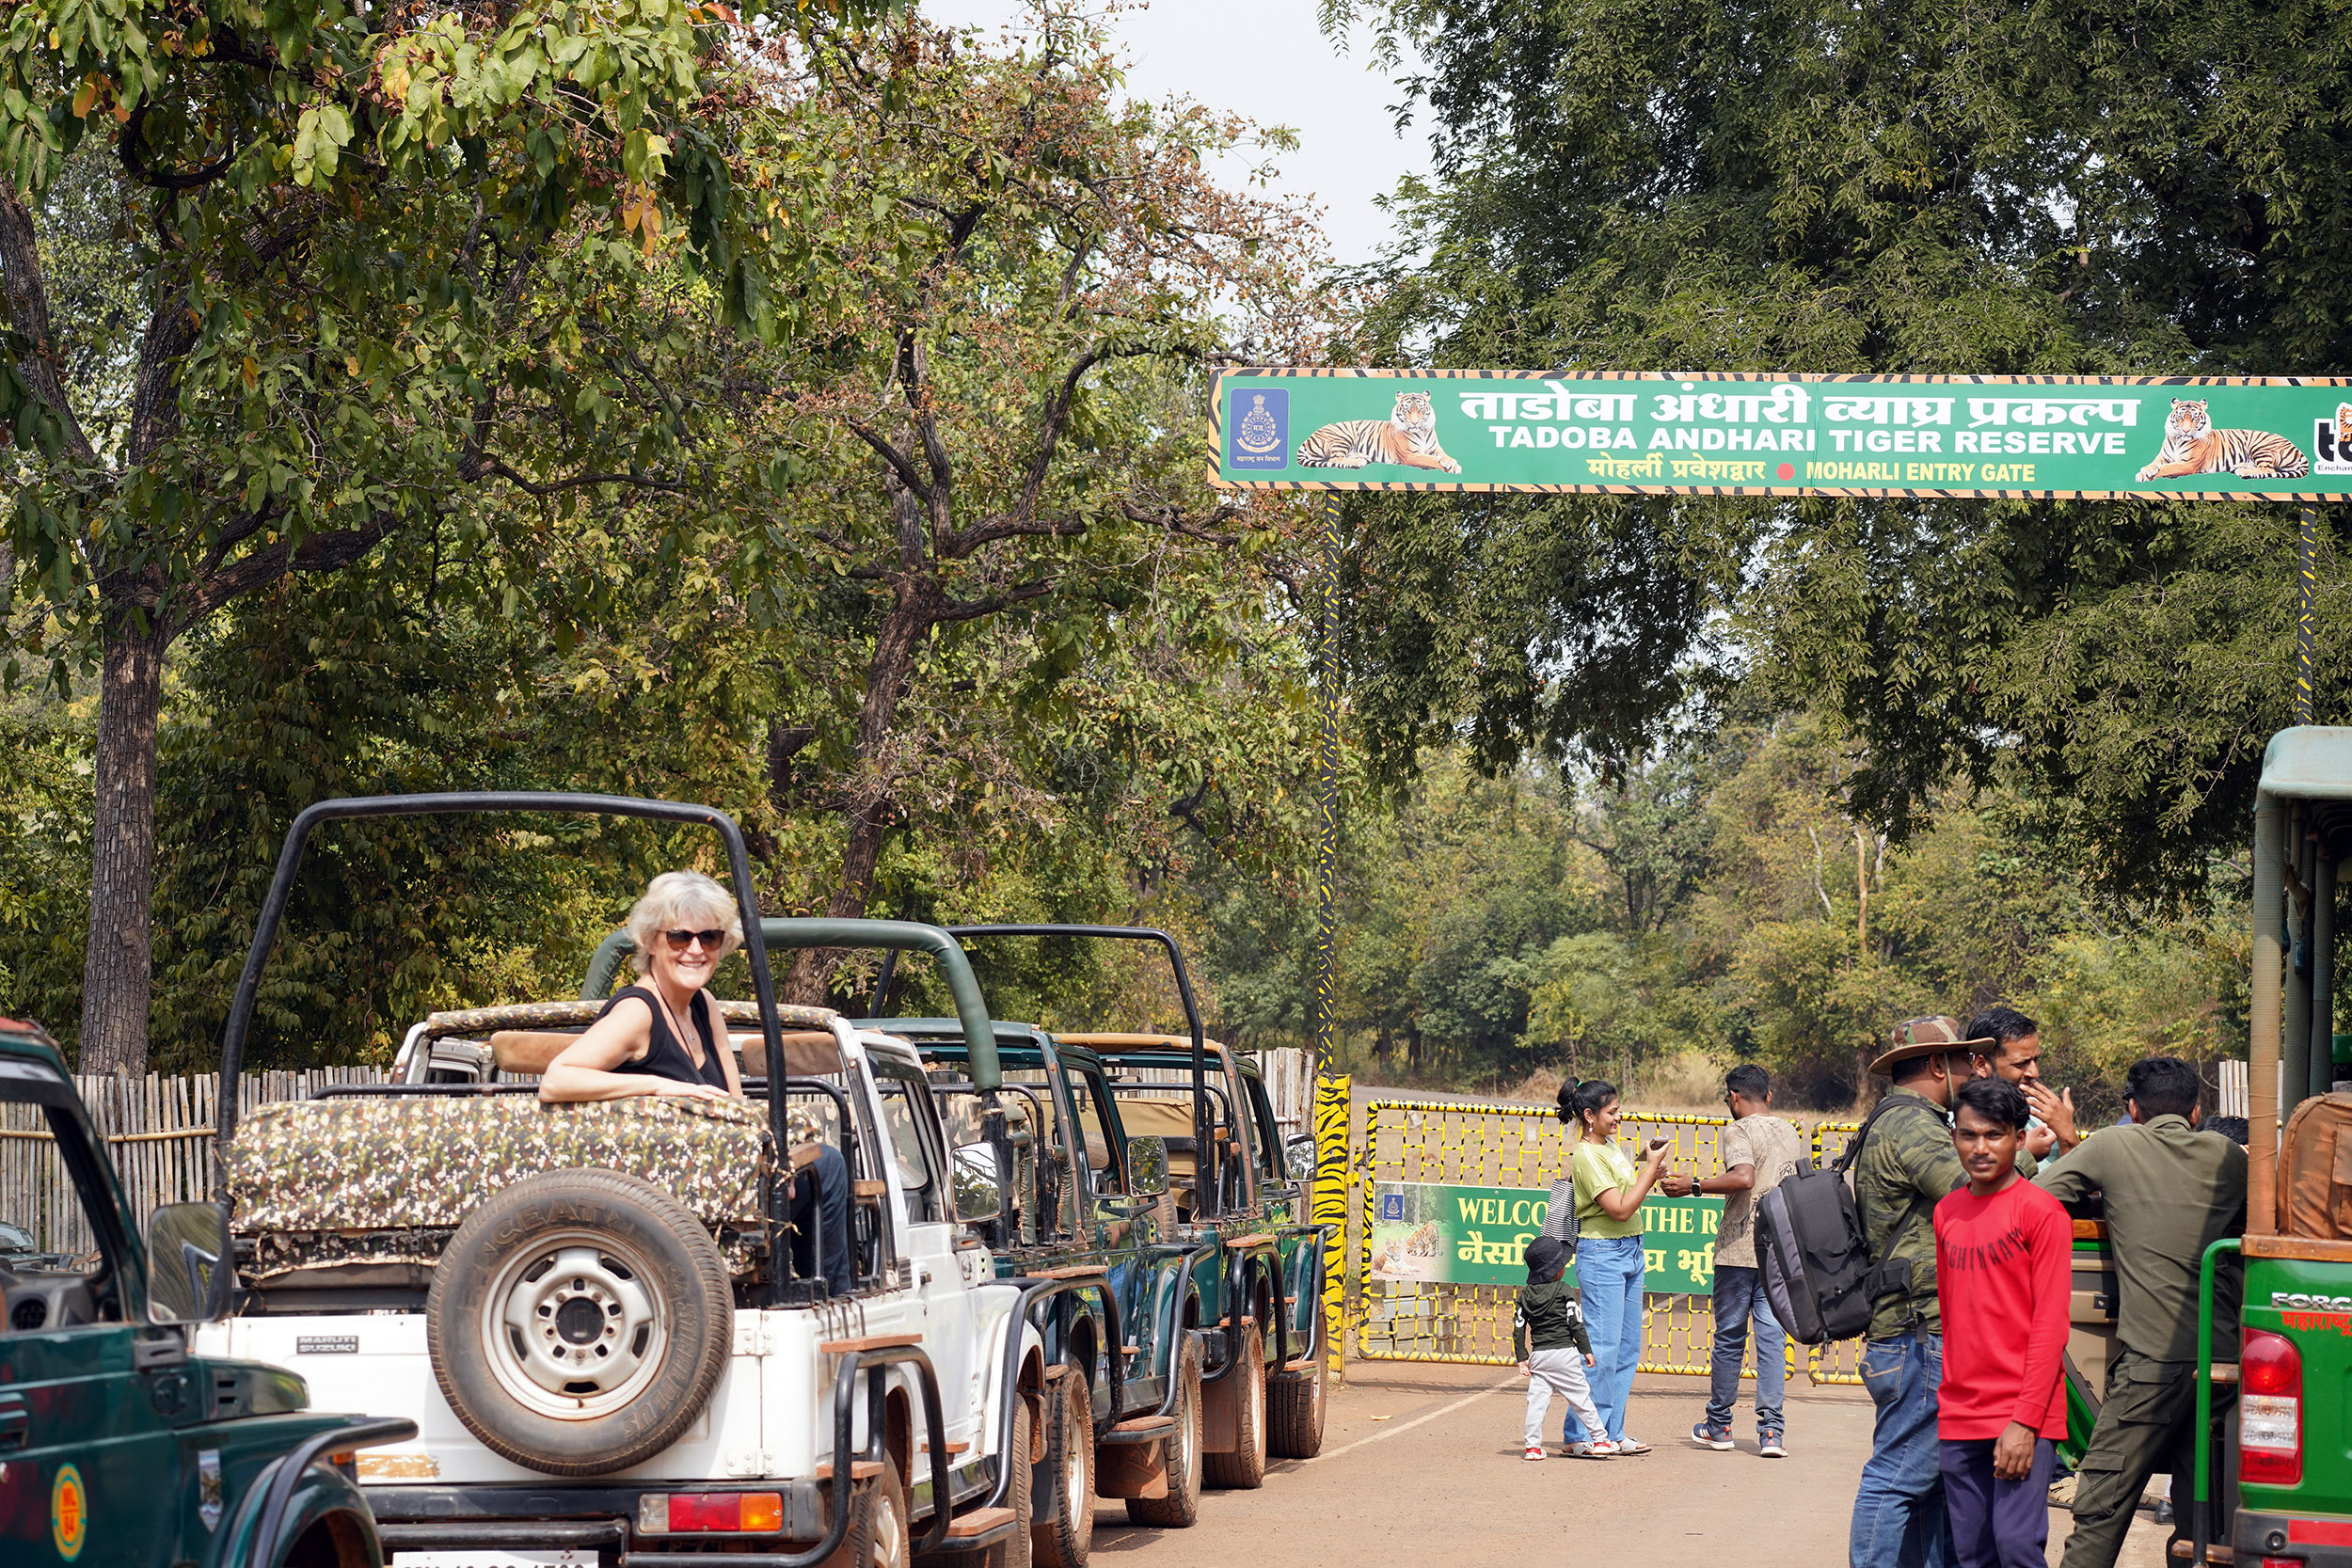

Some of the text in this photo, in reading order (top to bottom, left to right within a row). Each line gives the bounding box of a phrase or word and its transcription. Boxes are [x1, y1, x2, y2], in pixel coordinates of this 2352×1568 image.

[1459, 381, 2141, 429] ताडोबा अंधारी व्याघ्र प्रकल्प
[1488, 426, 2126, 455] TADOBA ANDHARI TIGER RESERVE
[1585, 451, 1767, 482] मोहर्ली प्रवेशद्वार
[1806, 462, 2035, 483] MOHARLI ENTRY GATE
[491, 1197, 607, 1245] CEAT
[1457, 1197, 1549, 1227] WELCO
[1641, 1206, 1694, 1234] THE
[299, 1336, 357, 1344] MARUTI
[299, 1343, 357, 1353] SUZUKI
